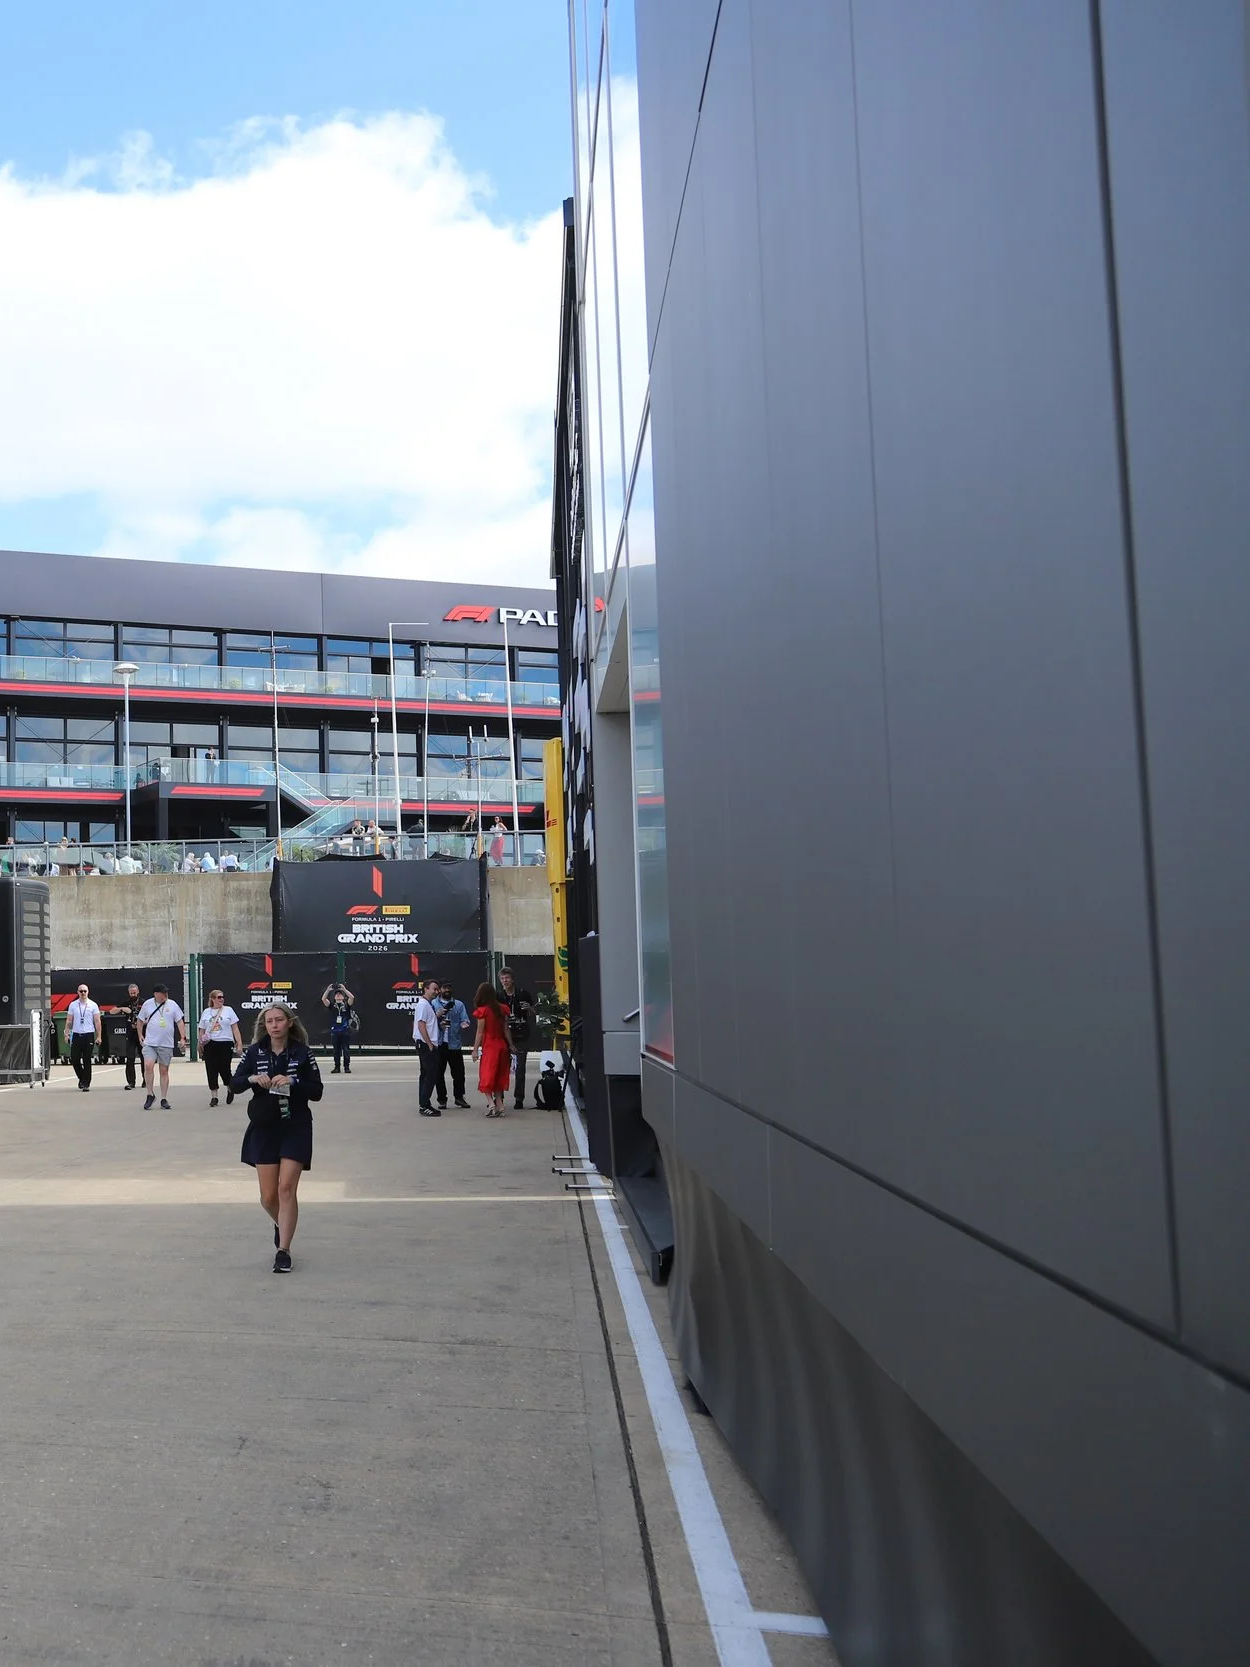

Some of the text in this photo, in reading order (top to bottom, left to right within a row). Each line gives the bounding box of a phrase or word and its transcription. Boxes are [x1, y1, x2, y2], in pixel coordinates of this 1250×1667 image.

[352, 924, 404, 933] BRITISH
[337, 934, 418, 943] GRAND PRIX
